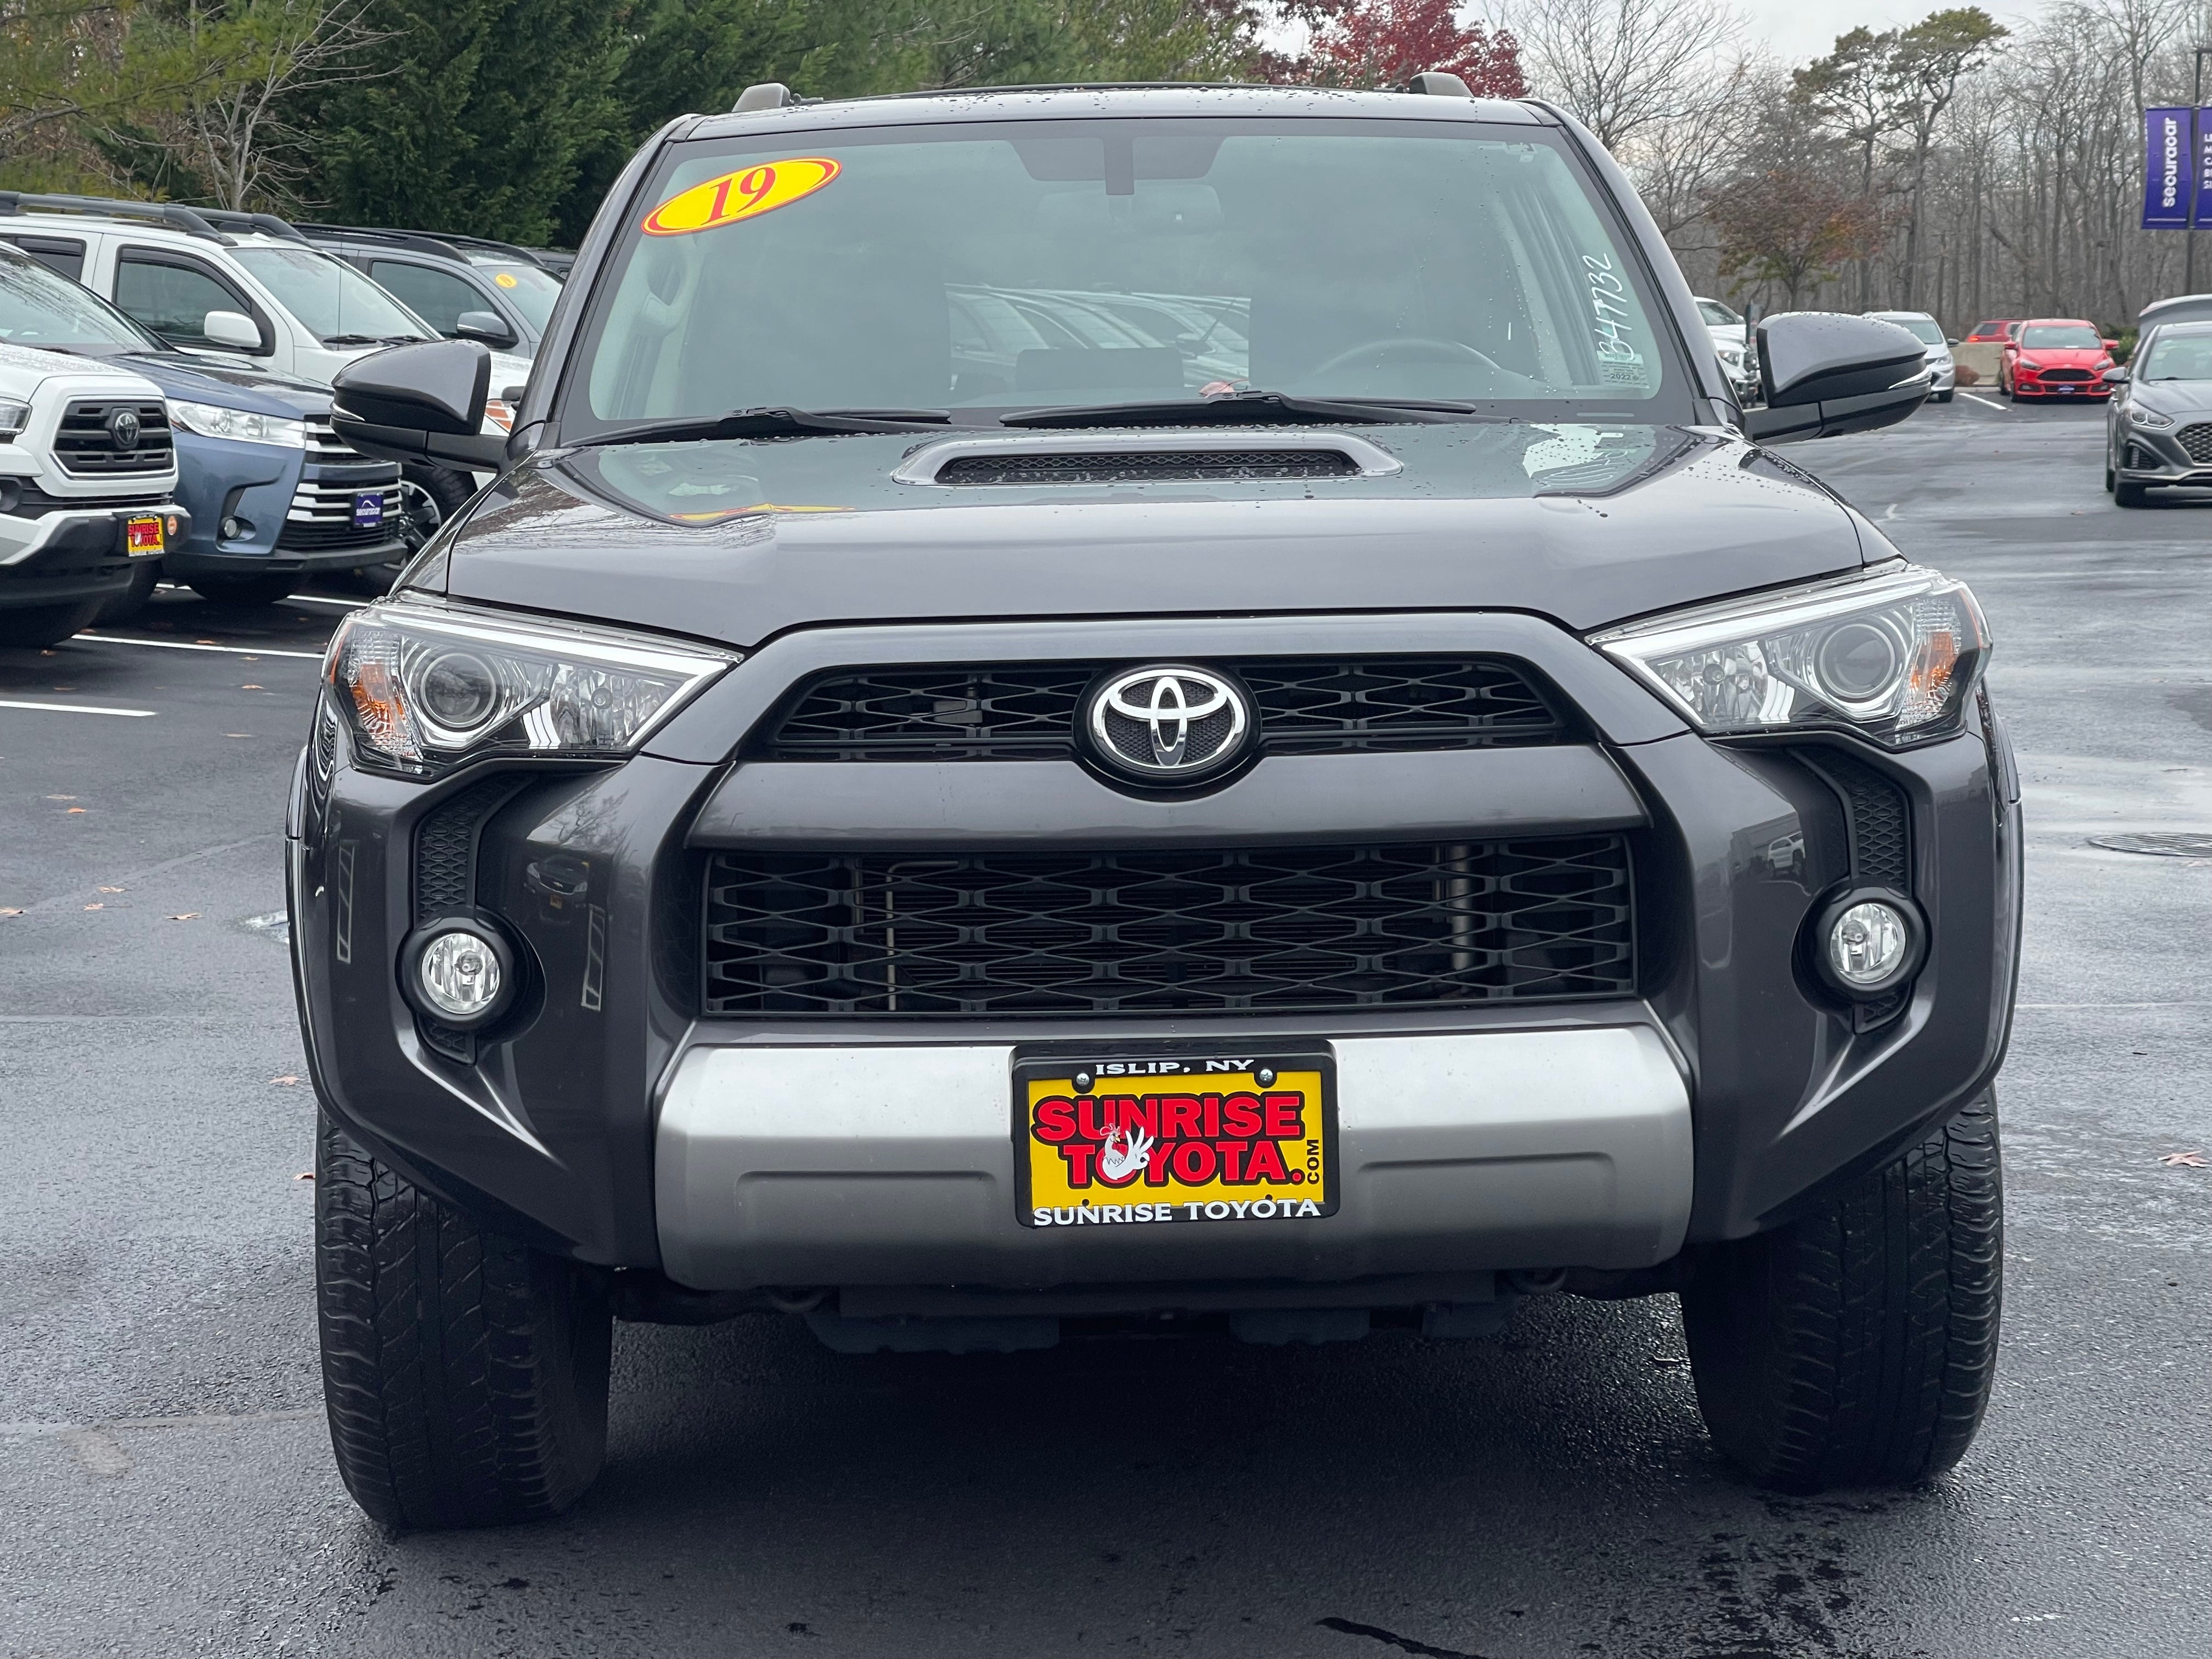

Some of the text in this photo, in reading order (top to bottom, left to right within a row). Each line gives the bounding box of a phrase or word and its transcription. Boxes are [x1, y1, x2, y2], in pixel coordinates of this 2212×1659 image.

[2163, 117, 2177, 207] securacar
[701, 167, 776, 225] 19
[131, 534, 159, 546] TYOTA
[1096, 1059, 1254, 1075] ISLIP, NY
[1036, 1096, 1300, 1141] SUNRISE
[1306, 1139, 1320, 1184] COM
[1034, 1198, 1322, 1226] SUNRISE TOYOTA
